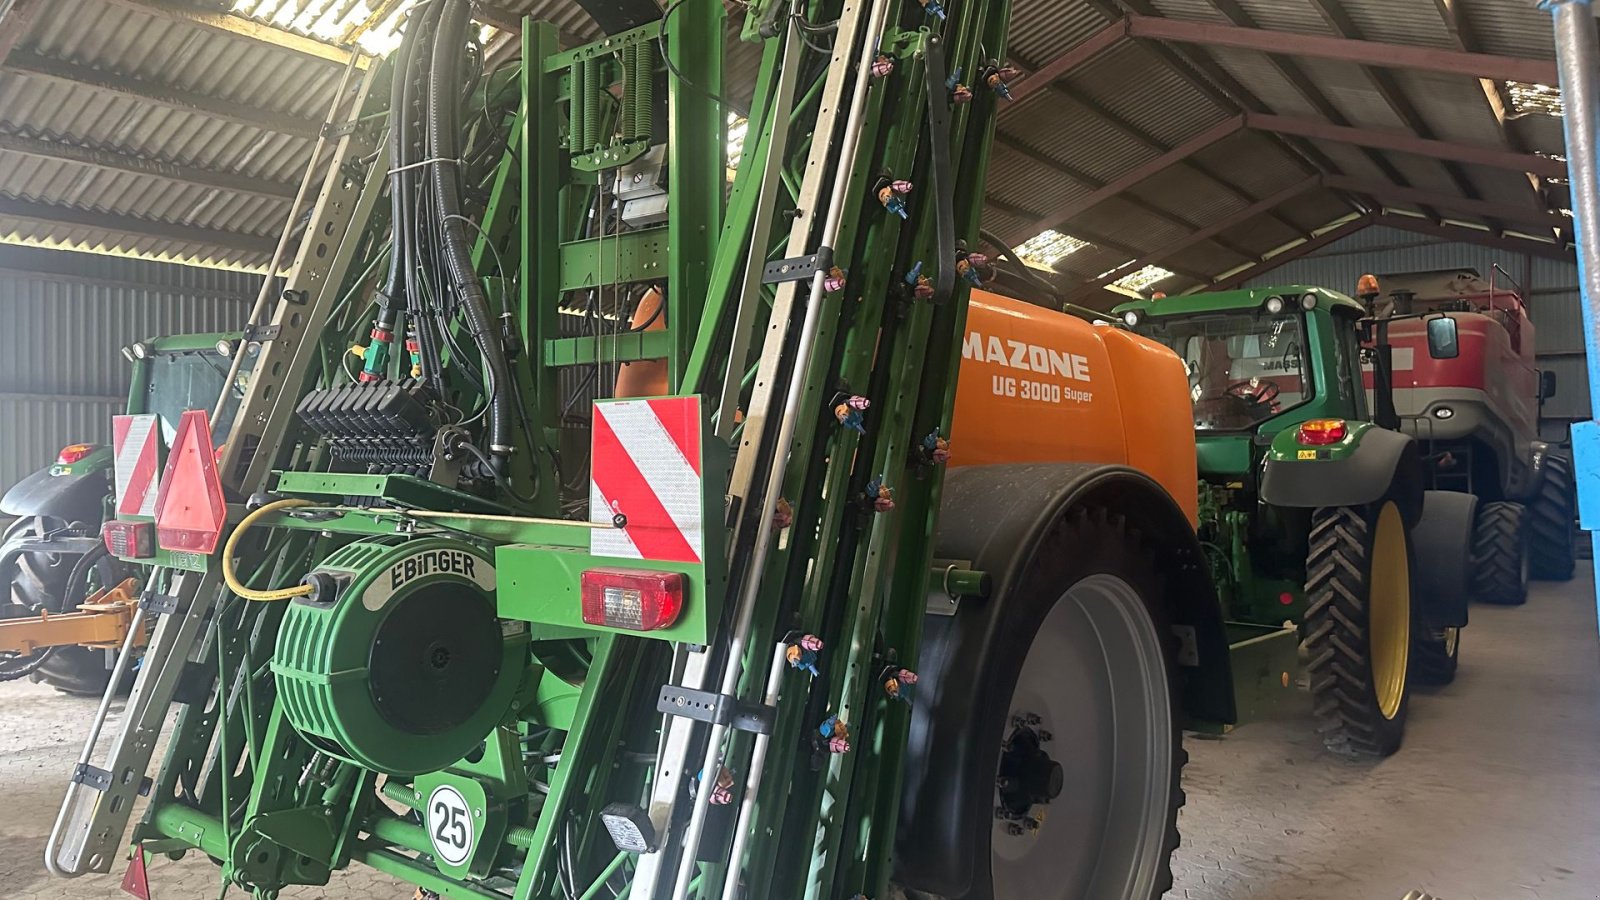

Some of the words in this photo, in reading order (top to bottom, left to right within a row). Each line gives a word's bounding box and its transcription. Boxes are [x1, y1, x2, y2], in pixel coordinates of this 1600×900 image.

[961, 331, 1091, 382] MAZONE
[1263, 360, 1298, 371] MASS
[992, 375, 1016, 397] UG
[1020, 380, 1061, 403] 3000
[1064, 387, 1093, 403] Super
[434, 801, 467, 850] 25
